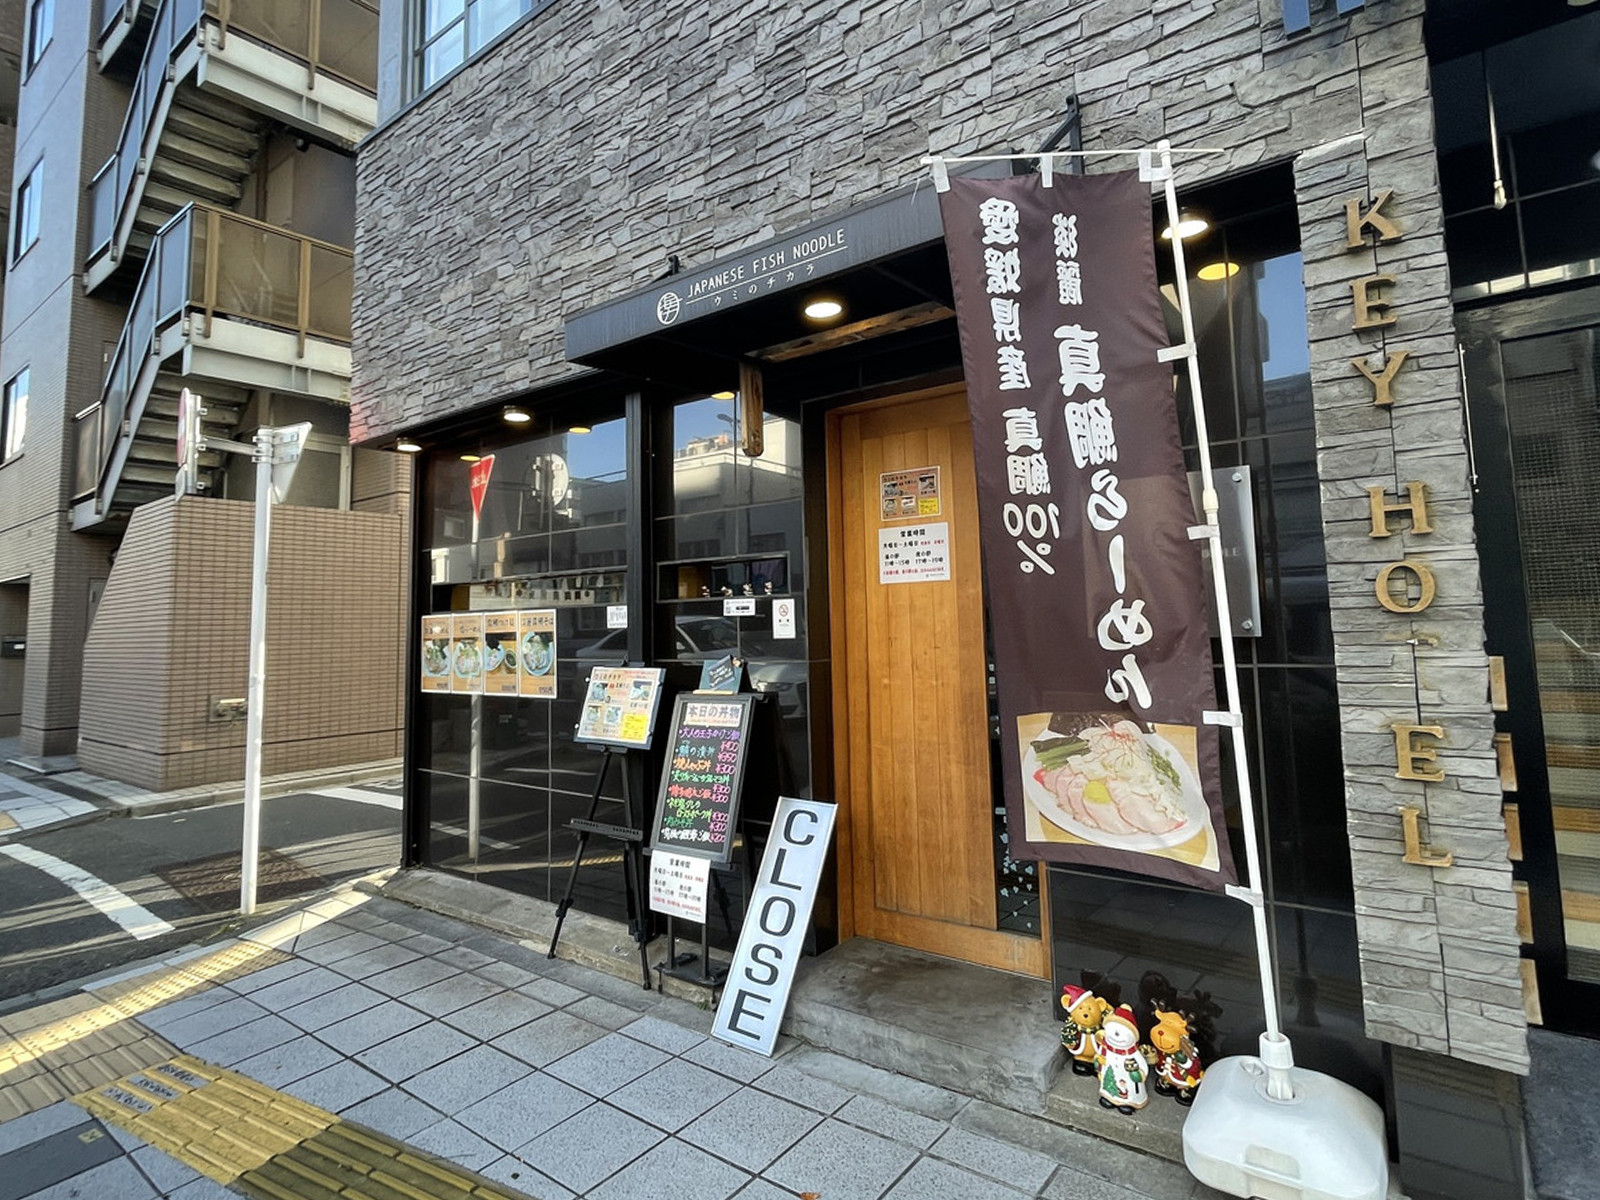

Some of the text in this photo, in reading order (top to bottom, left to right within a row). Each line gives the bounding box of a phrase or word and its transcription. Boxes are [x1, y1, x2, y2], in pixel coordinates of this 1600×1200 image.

[687, 228, 846, 299] JAPANESE FISH NOODLE
[713, 263, 815, 306] ウミのチカラ
[1344, 188, 1408, 406] KEY
[1367, 480, 1454, 868] HOEL
[726, 809, 819, 1040] CLOSE
